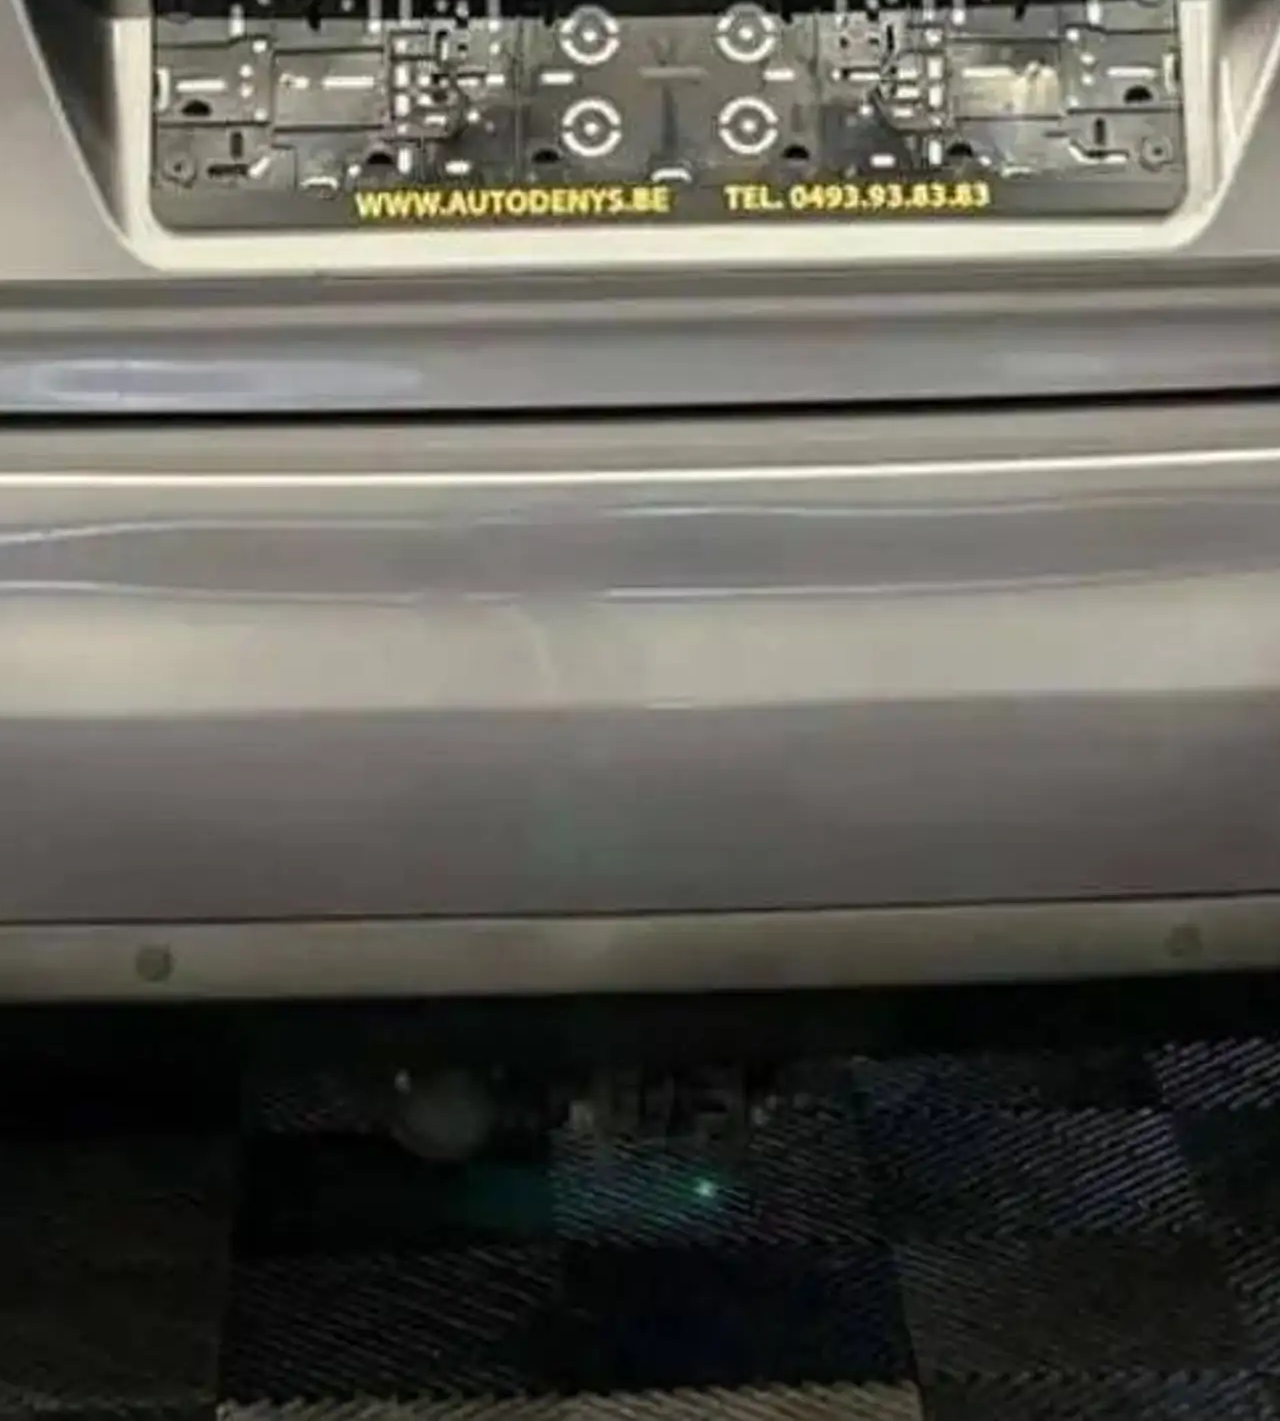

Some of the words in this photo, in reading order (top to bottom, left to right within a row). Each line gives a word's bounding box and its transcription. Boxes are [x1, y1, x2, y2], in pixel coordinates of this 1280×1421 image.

[354, 186, 670, 218] WWW.AUTODENYS.BE
[723, 184, 784, 210] TEL.
[789, 182, 992, 209] 0493.93.83.83
